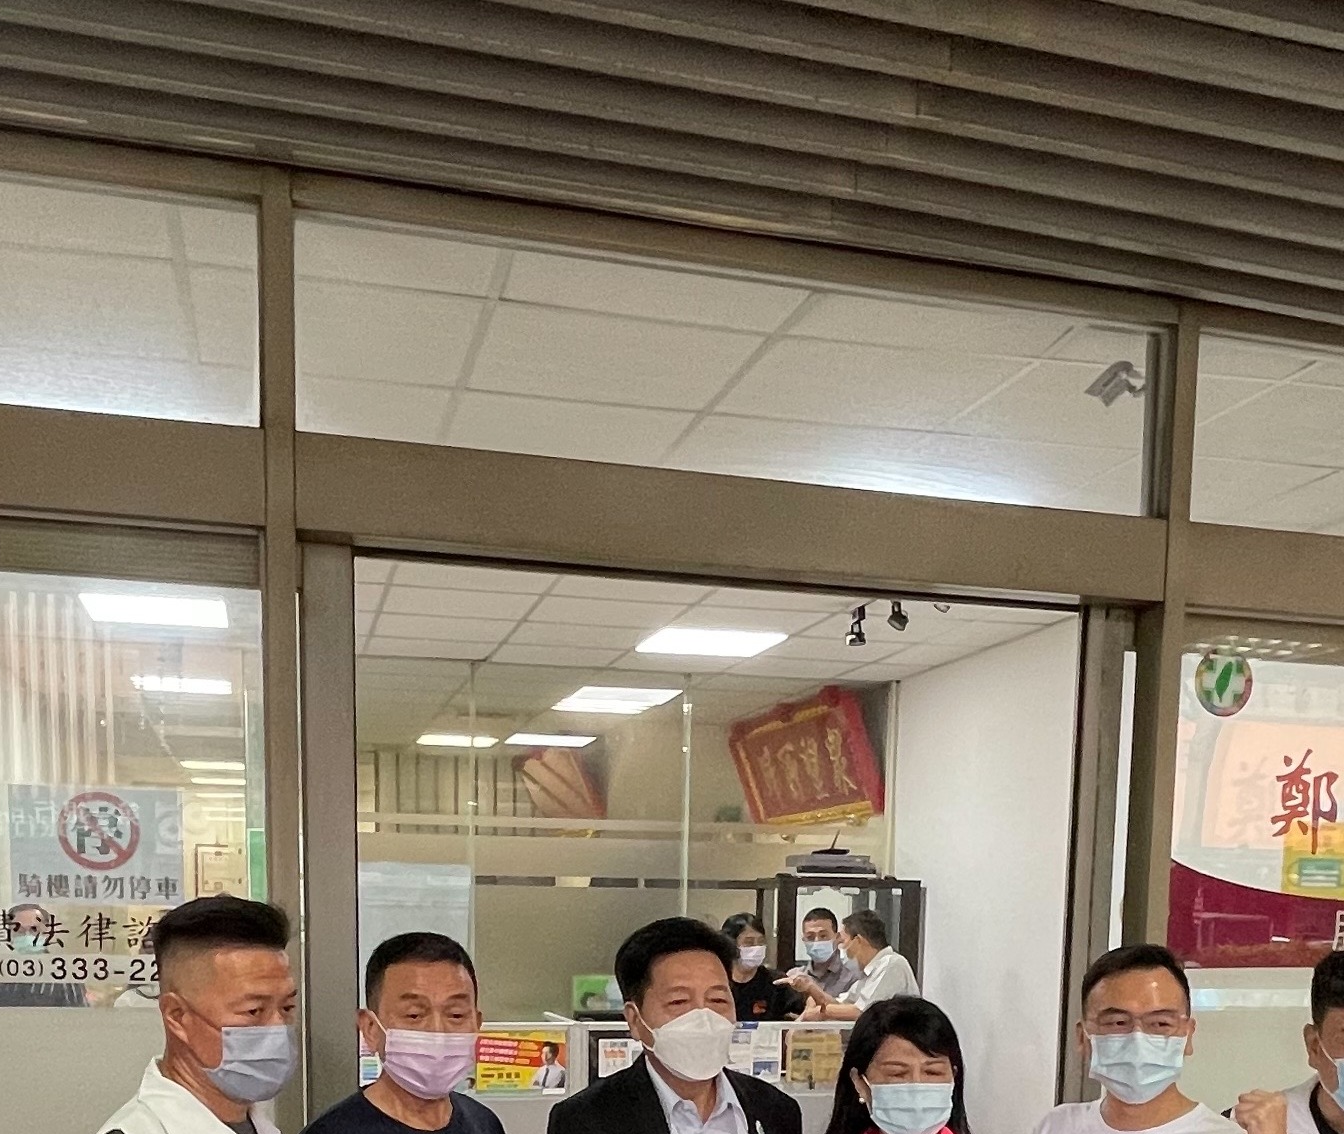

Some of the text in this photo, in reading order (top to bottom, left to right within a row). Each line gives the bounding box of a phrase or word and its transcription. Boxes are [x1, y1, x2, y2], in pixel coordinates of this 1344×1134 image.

[18, 873, 181, 900] 騎樓請勿停車
